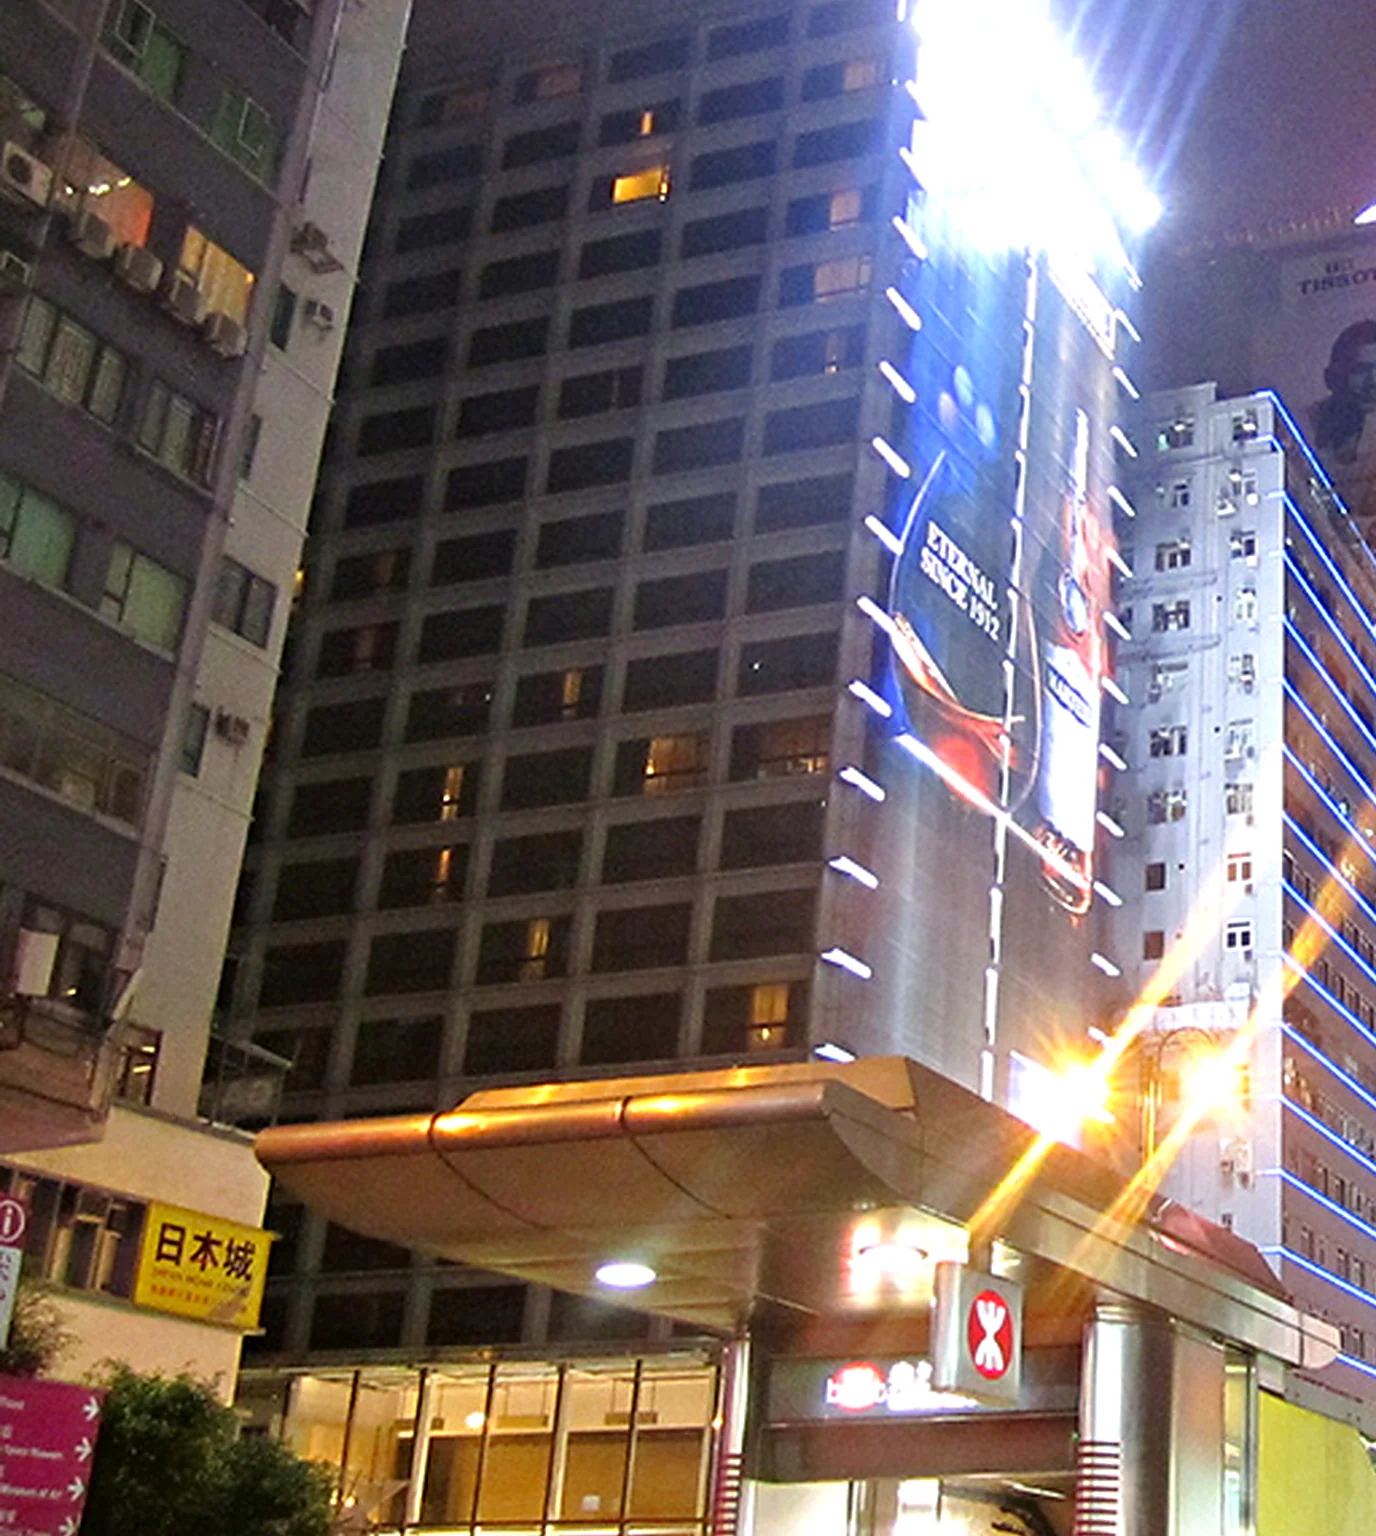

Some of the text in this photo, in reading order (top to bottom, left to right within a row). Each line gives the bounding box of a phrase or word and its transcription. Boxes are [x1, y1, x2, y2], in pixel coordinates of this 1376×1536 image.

[920, 546, 1000, 641] SINCE 1912
[927, 520, 998, 610] ETERNAL
[155, 1222, 256, 1282] 日本城
